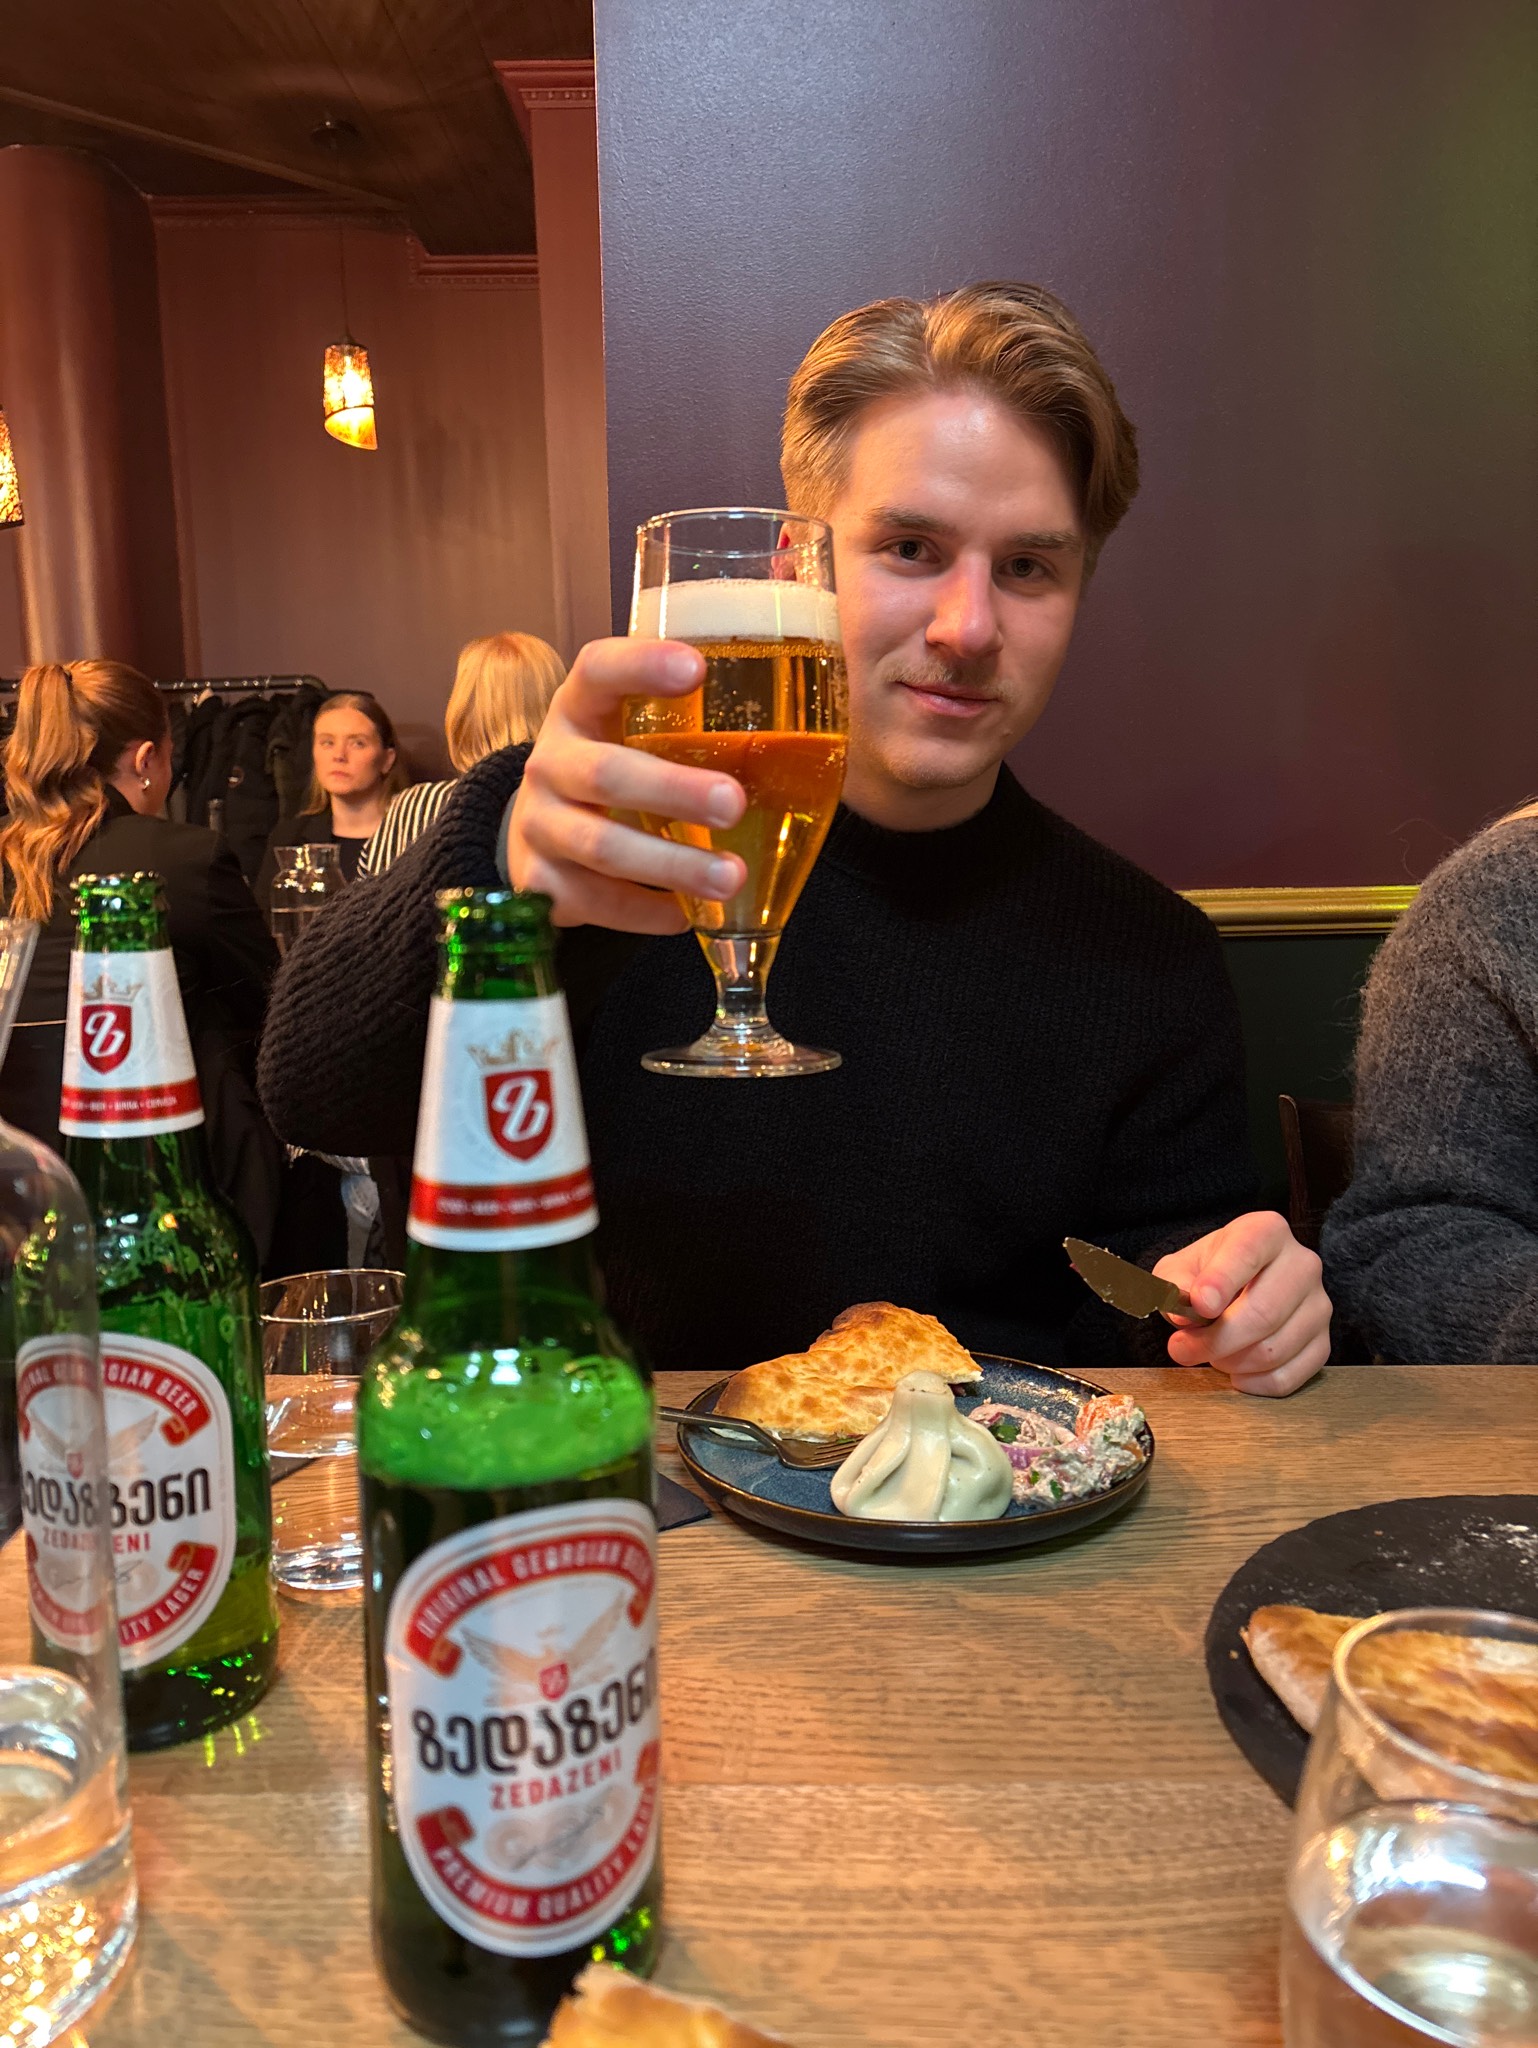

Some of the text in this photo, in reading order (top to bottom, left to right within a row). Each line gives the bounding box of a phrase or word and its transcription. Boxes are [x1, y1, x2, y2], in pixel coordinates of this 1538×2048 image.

[155, 1378, 199, 1417] BEER
[154, 1567, 205, 1623] LAGER
[489, 1747, 622, 1811] ZEDAZENI
[433, 1845, 529, 1919] PREMIUM
